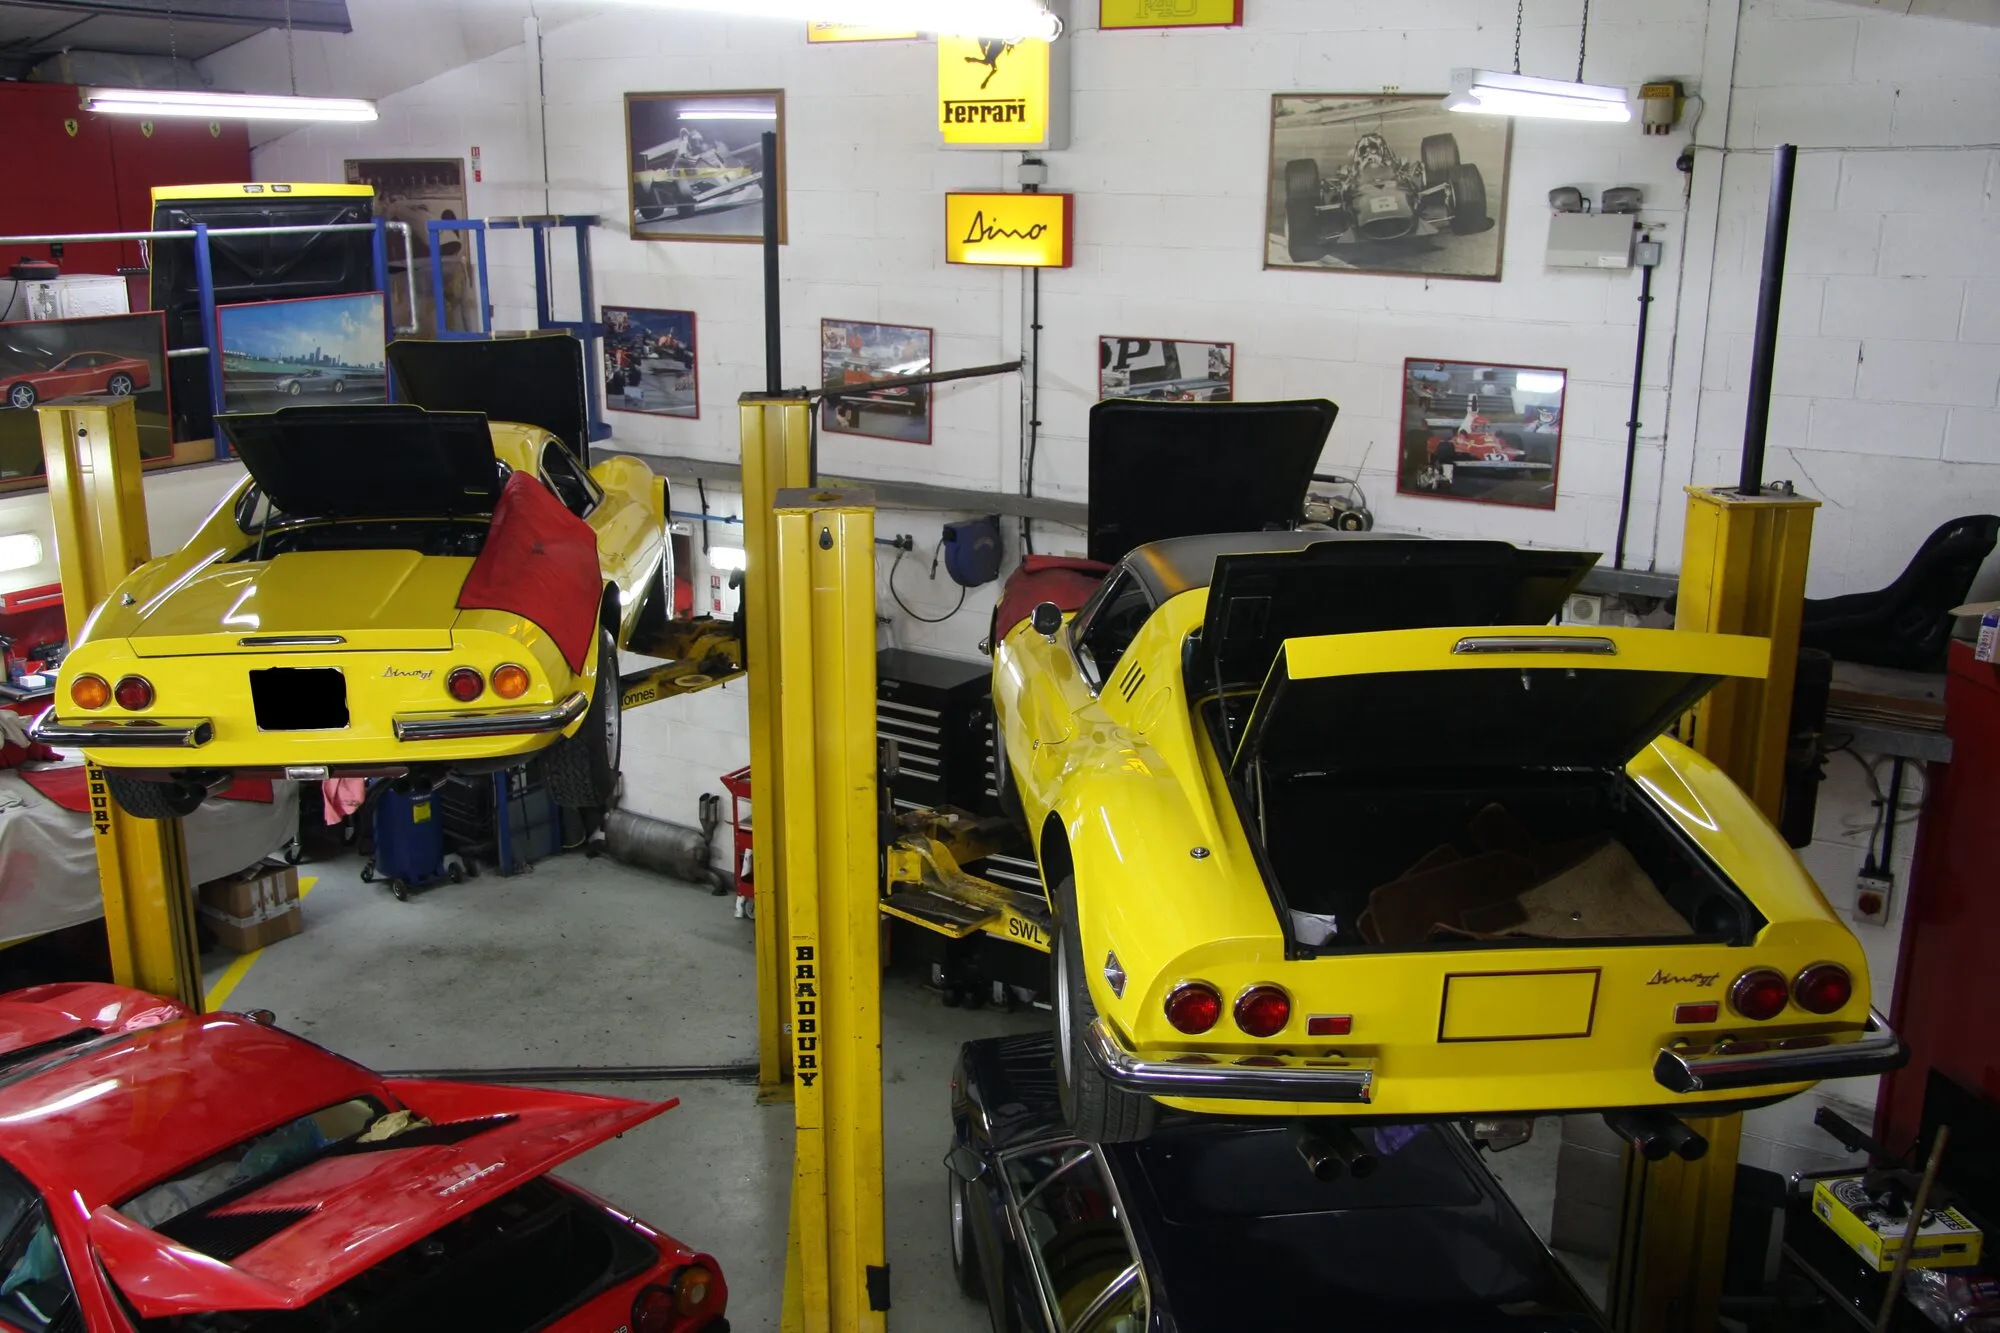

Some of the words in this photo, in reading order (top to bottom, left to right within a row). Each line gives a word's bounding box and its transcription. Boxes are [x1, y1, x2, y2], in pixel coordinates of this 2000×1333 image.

[943, 98, 1026, 123] Ferrari
[962, 210, 1047, 244] Dino
[621, 688, 656, 706] onnes
[1009, 917, 1042, 944] SWL
[795, 946, 818, 1086] BRADBURY
